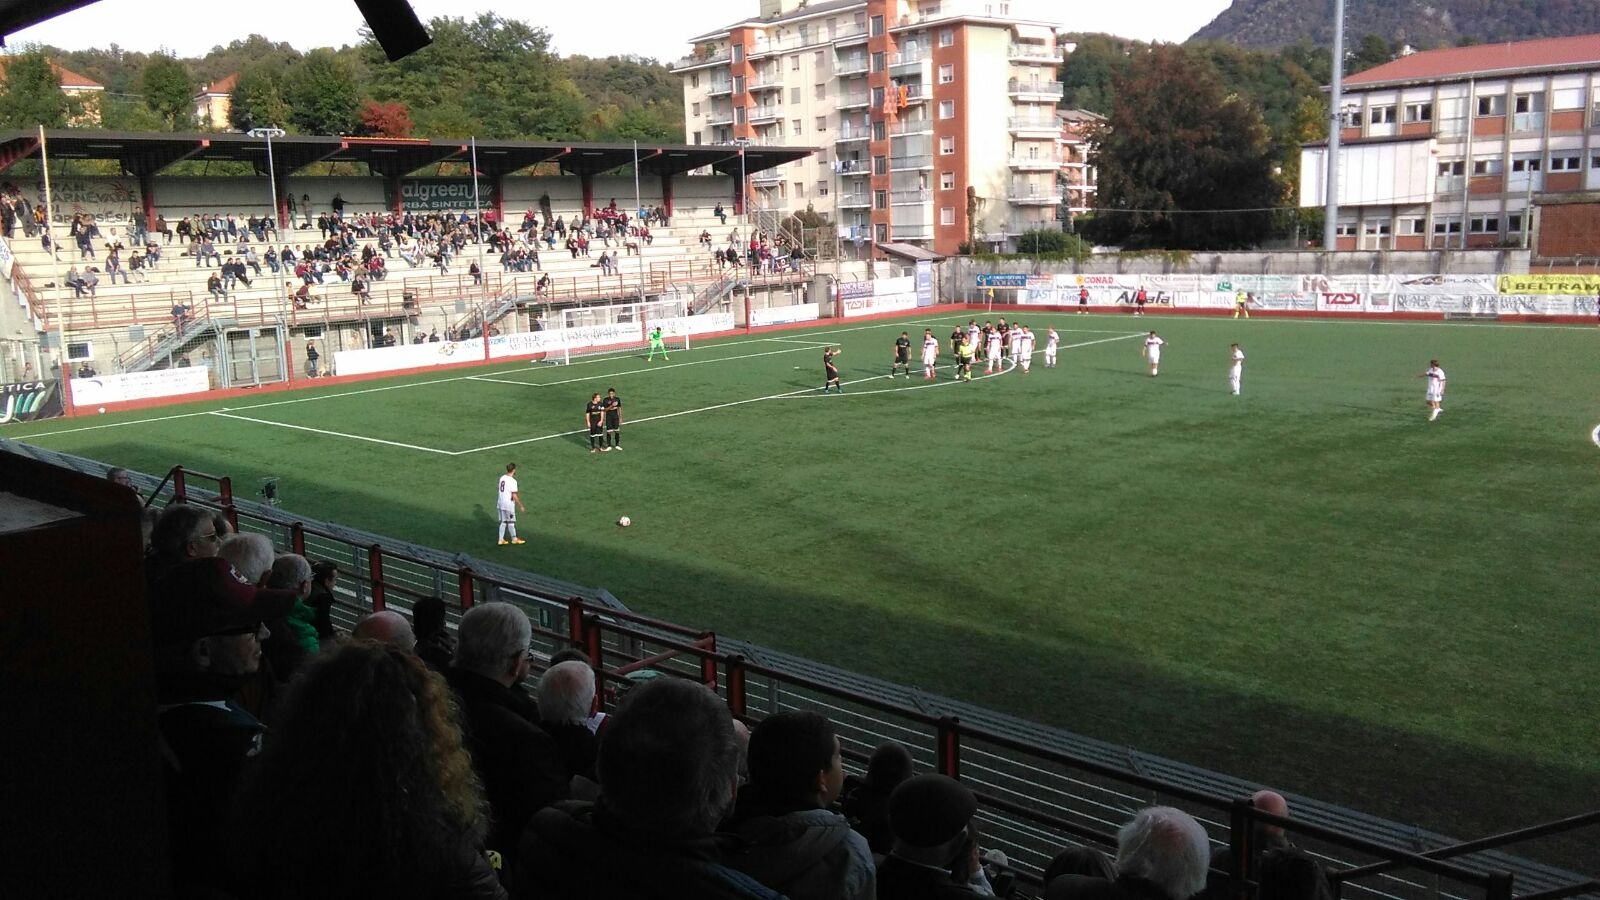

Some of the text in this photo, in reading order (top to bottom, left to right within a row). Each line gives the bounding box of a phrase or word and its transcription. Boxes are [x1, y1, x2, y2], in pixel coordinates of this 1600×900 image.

[1084, 276, 1113, 284] CONAD
[1322, 293, 1361, 305] TADI
[846, 300, 865, 311] TADI
[500, 480, 505, 492] 8
